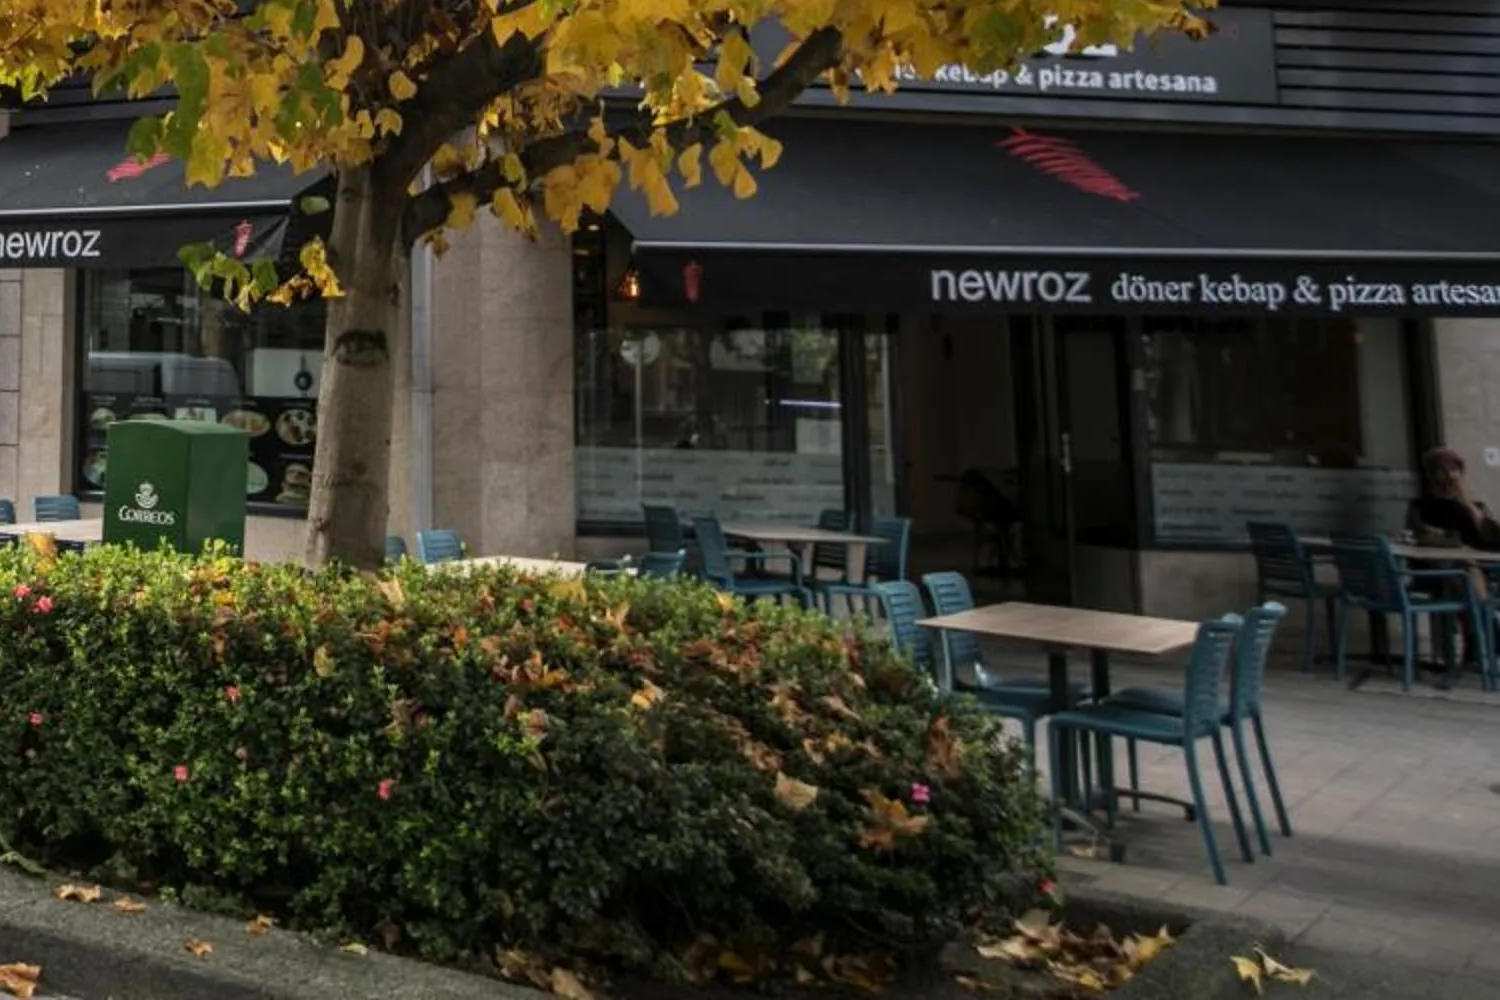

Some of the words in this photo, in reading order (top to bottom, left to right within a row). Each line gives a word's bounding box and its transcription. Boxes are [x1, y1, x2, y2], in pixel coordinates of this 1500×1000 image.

[1014, 64, 1034, 86] &
[1039, 64, 1103, 91] pizza
[1108, 70, 1218, 94] artesana
[931, 269, 1093, 303] newroz
[1110, 272, 1194, 302] döner
[1198, 272, 1287, 311] kebap
[1293, 275, 1322, 303] &
[1327, 275, 1405, 312] pizza
